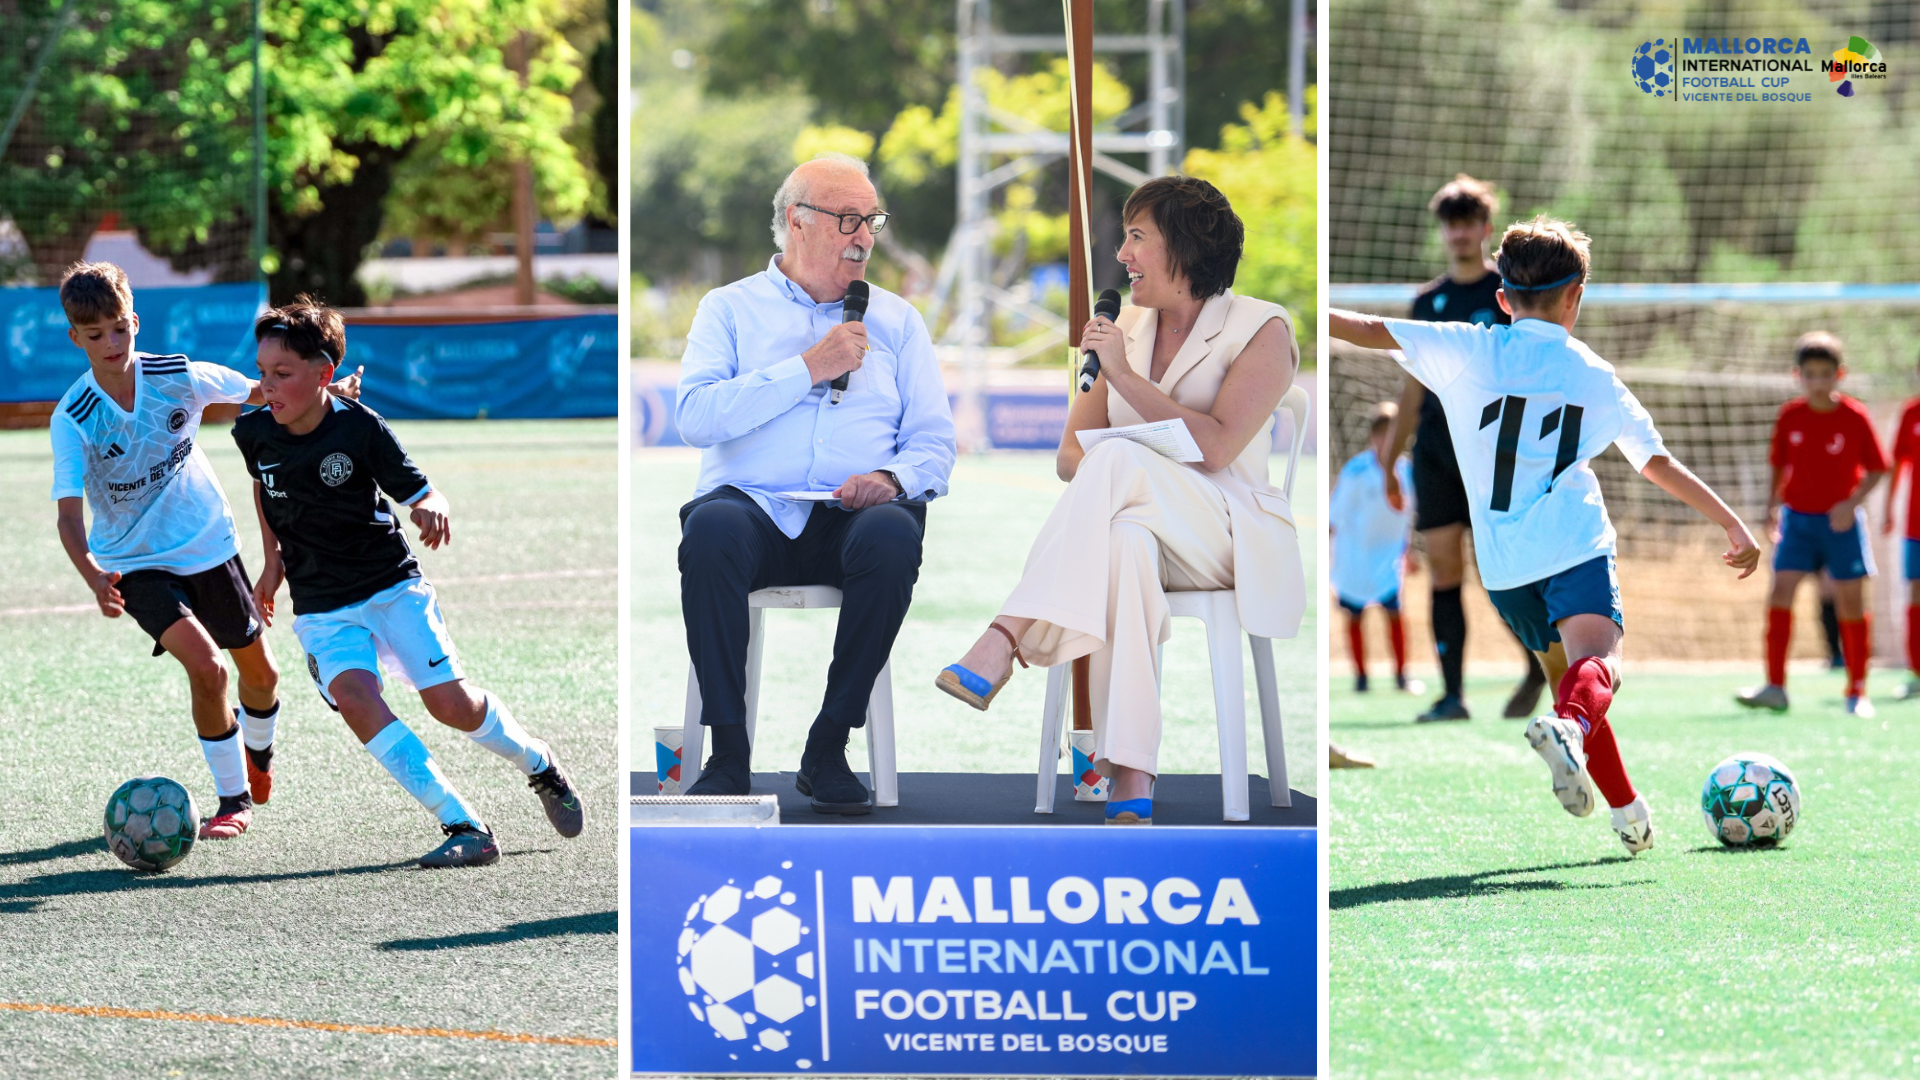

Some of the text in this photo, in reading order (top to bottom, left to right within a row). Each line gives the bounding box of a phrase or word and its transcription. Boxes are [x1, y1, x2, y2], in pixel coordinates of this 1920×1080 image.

[1479, 394, 1584, 512] 11
[108, 477, 146, 492] VICENTE
[150, 469, 166, 483] DEL
[852, 876, 1260, 926] MALLORCA
[854, 938, 1270, 975] INTERNATIONAL
[855, 988, 1197, 1022] FOOTBALL CUP
[884, 1033, 1168, 1054] VICENTE DEL BOSQUE
